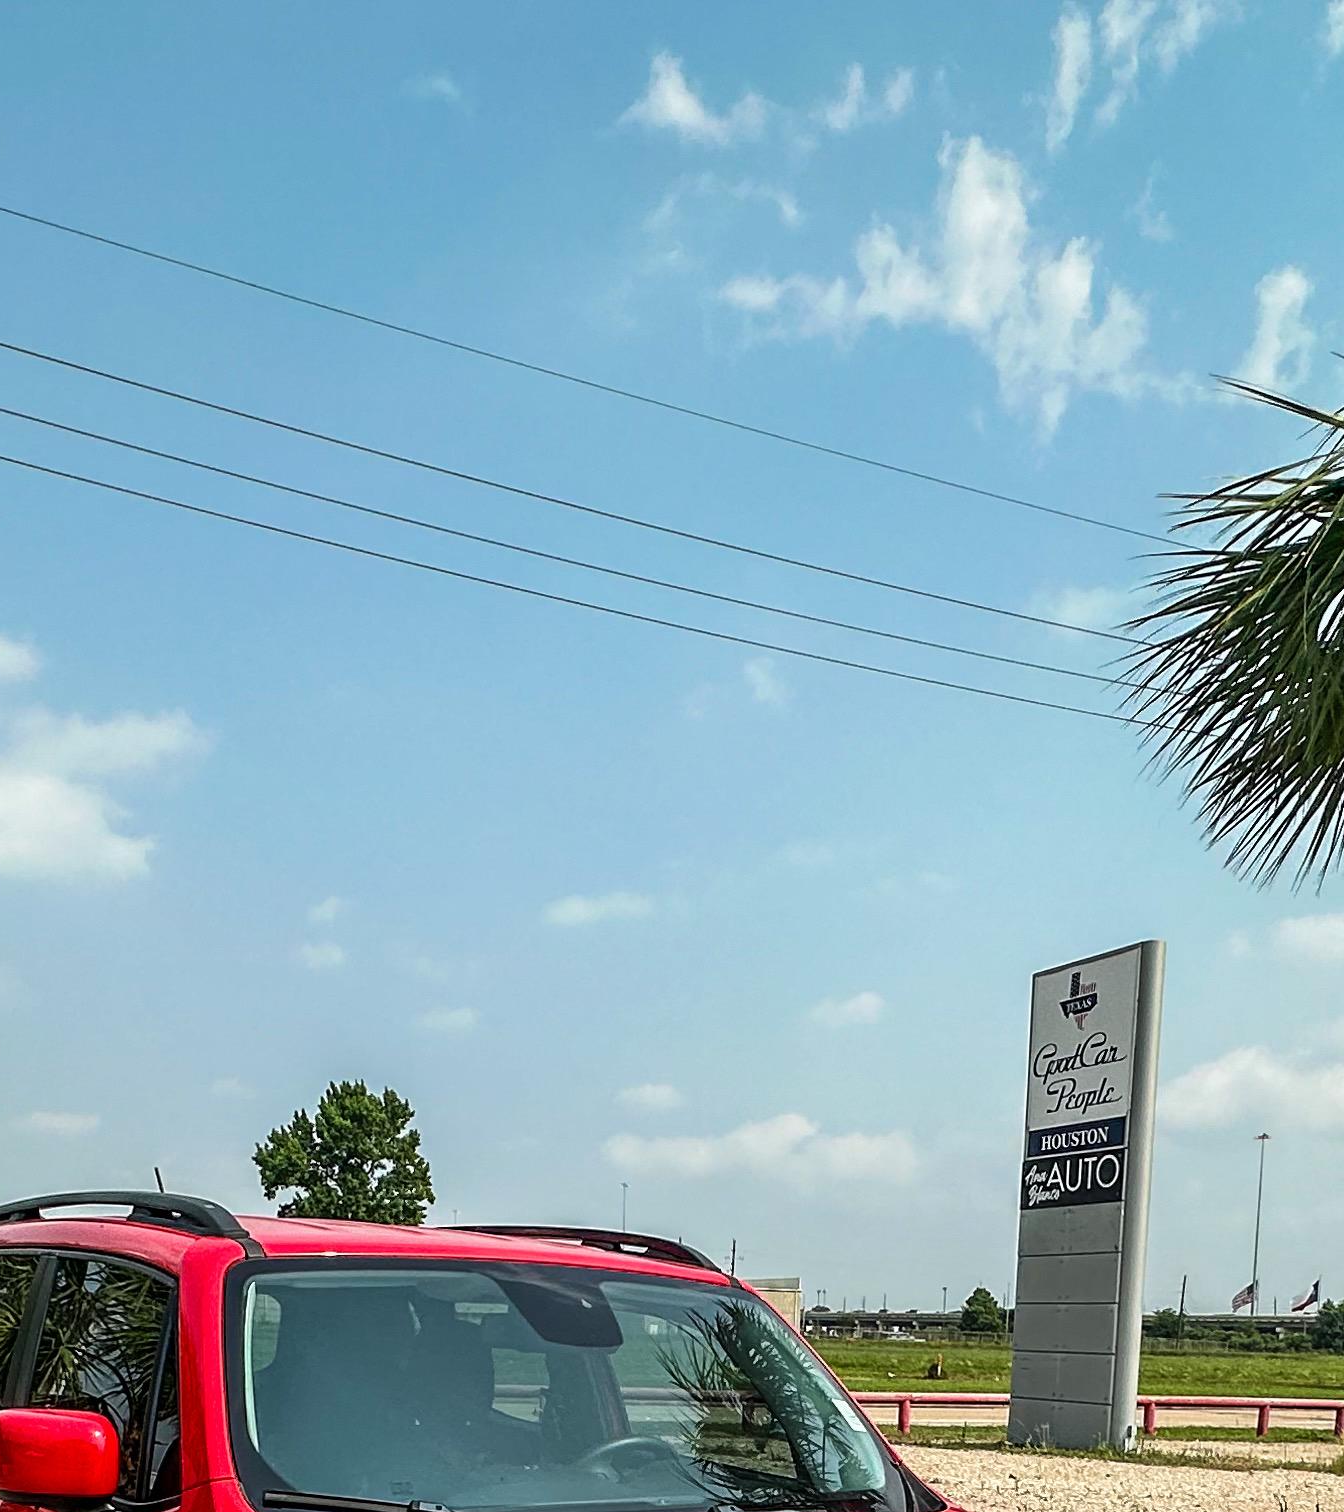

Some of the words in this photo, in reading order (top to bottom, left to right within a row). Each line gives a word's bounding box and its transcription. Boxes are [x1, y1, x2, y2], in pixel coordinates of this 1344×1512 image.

[1033, 1043, 1082, 1085] Good
[1080, 1032, 1127, 1067] Car
[1047, 1078, 1123, 1114] People
[1041, 1127, 1109, 1151] HOUSTON
[1046, 1154, 1120, 1192] AUTO
